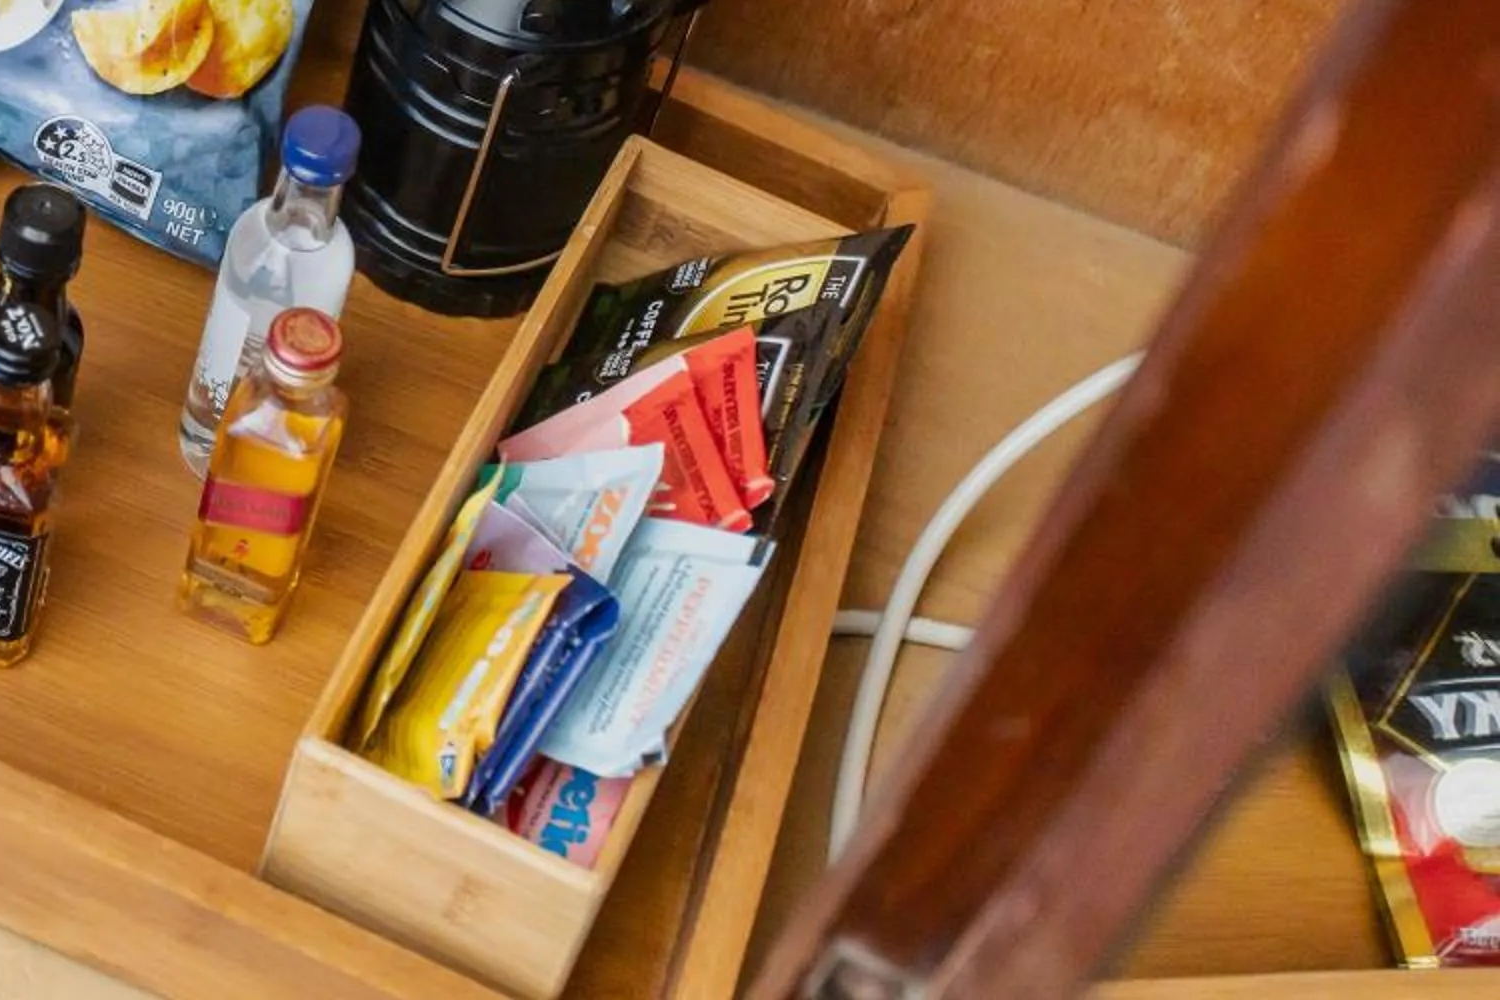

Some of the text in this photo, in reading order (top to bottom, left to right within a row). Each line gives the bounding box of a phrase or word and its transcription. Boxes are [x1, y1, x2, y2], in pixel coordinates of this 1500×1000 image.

[163, 199, 197, 225] 90g
[165, 221, 204, 246] NET
[819, 273, 847, 301] THE
